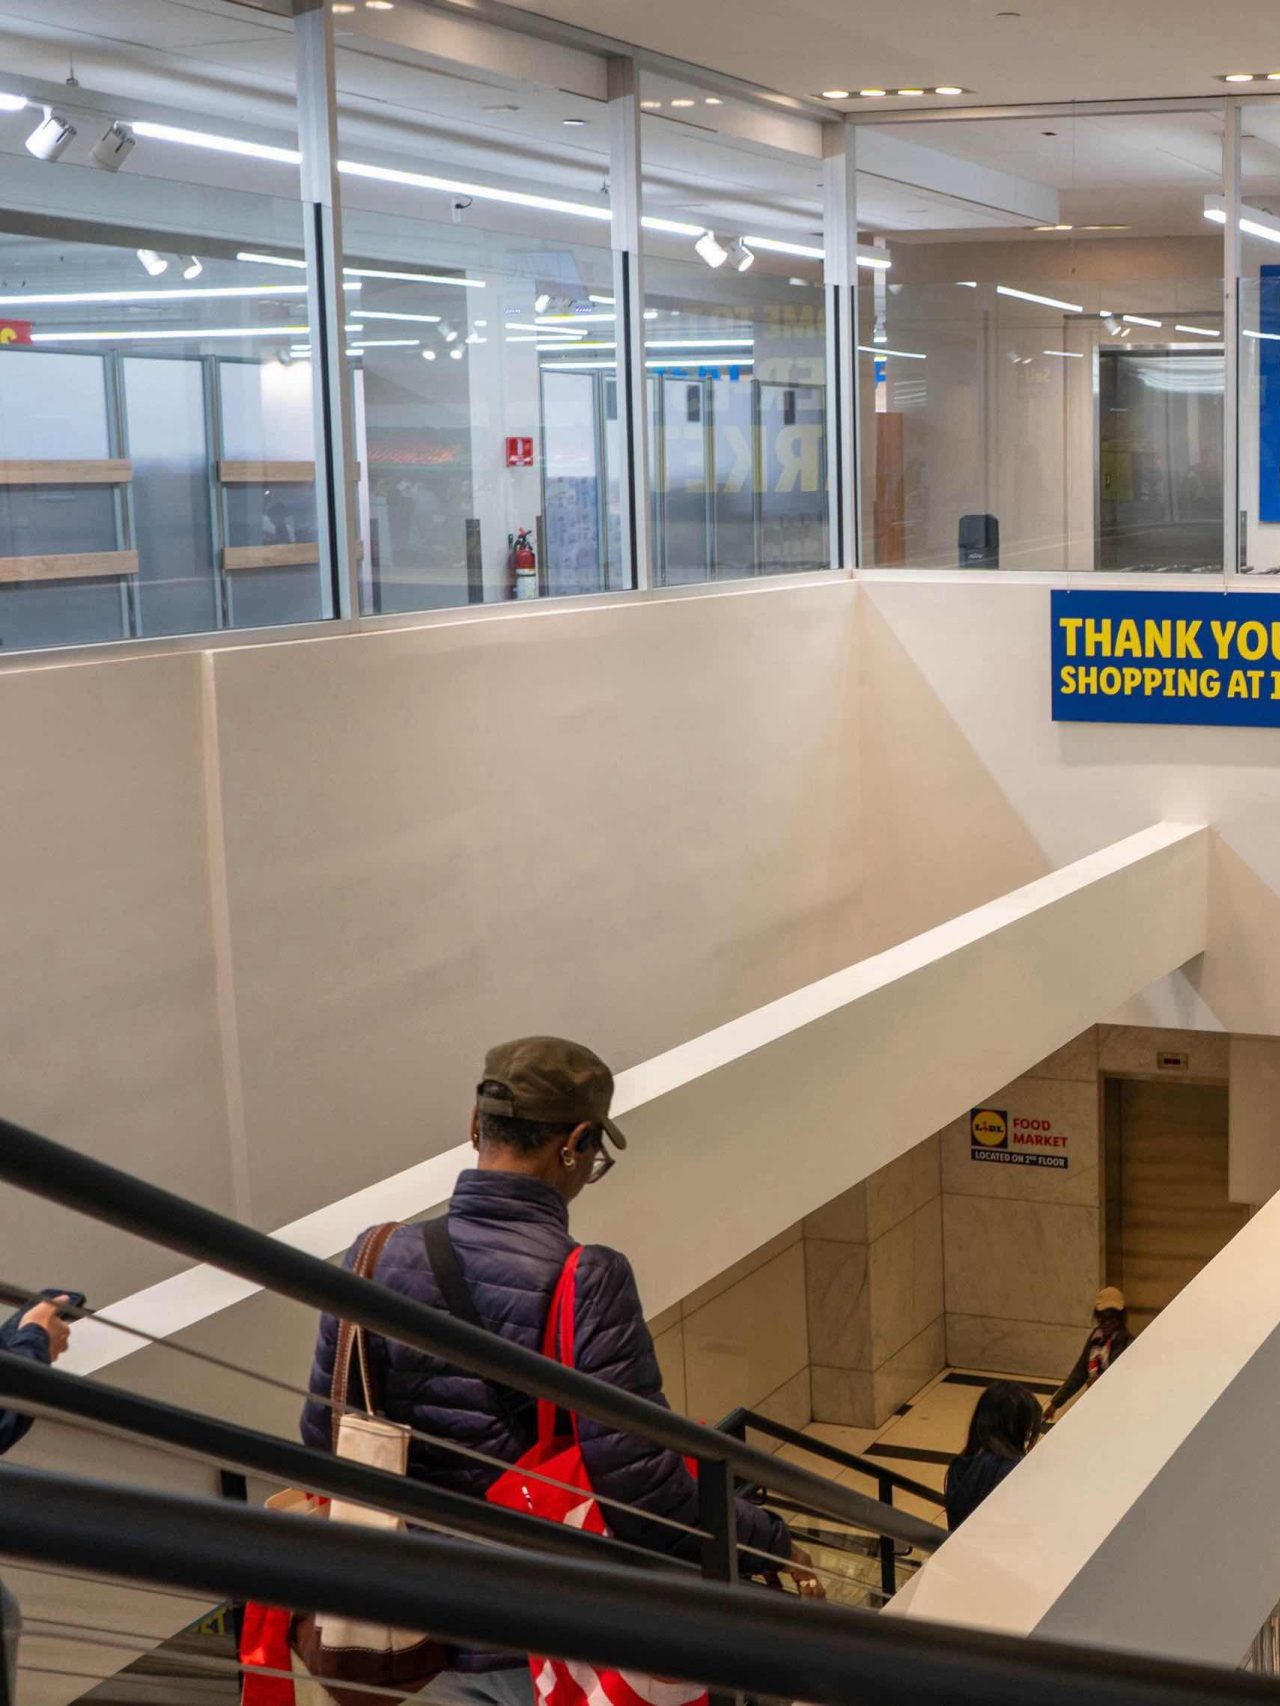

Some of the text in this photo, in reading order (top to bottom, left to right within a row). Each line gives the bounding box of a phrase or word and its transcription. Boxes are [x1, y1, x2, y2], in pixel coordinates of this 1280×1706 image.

[1059, 618, 1203, 659] THANK
[1059, 665, 1222, 698] SHOPPING
[1227, 670, 1265, 699] AT
[1013, 1118, 1051, 1131] FOOD
[1013, 1133, 1068, 1147] MARKET
[975, 1151, 1010, 1161] LOCATED
[1012, 1154, 1024, 1163] ON
[1039, 1157, 1065, 1167] FLOOR
